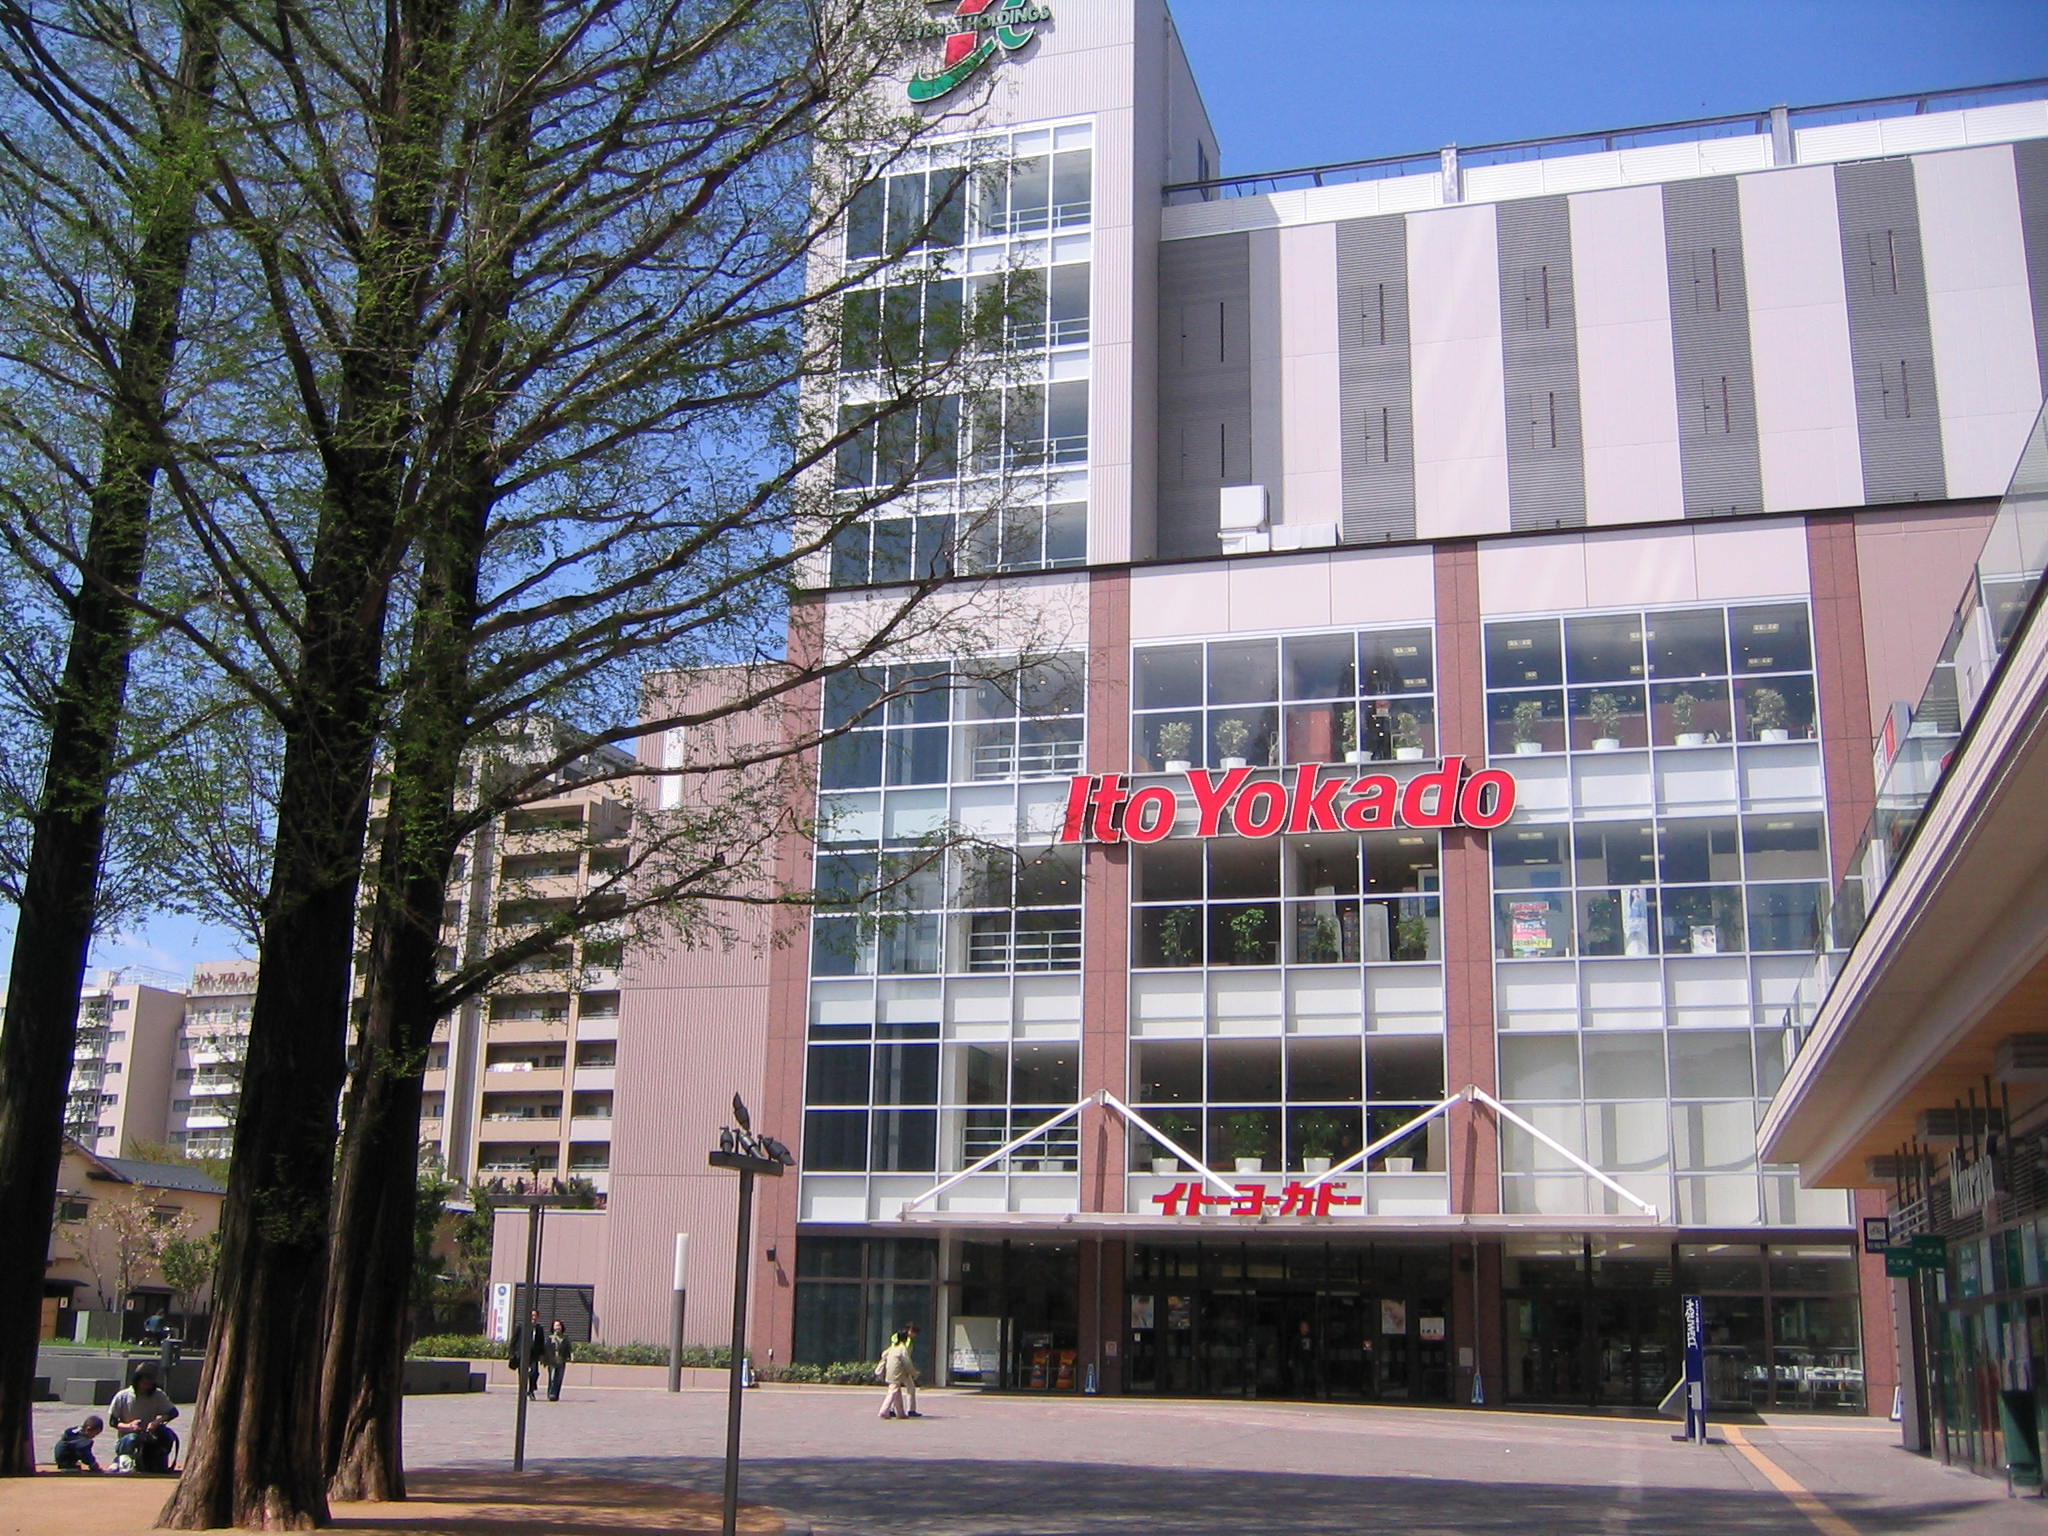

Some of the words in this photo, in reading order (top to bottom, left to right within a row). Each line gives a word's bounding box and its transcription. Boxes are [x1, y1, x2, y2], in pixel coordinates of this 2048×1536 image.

[968, 6, 1050, 29] HOLDINGS
[1059, 772, 1177, 844] Ito
[1186, 755, 1517, 840] Yokado
[1152, 1181, 1363, 1217] イトーヨーカドー
